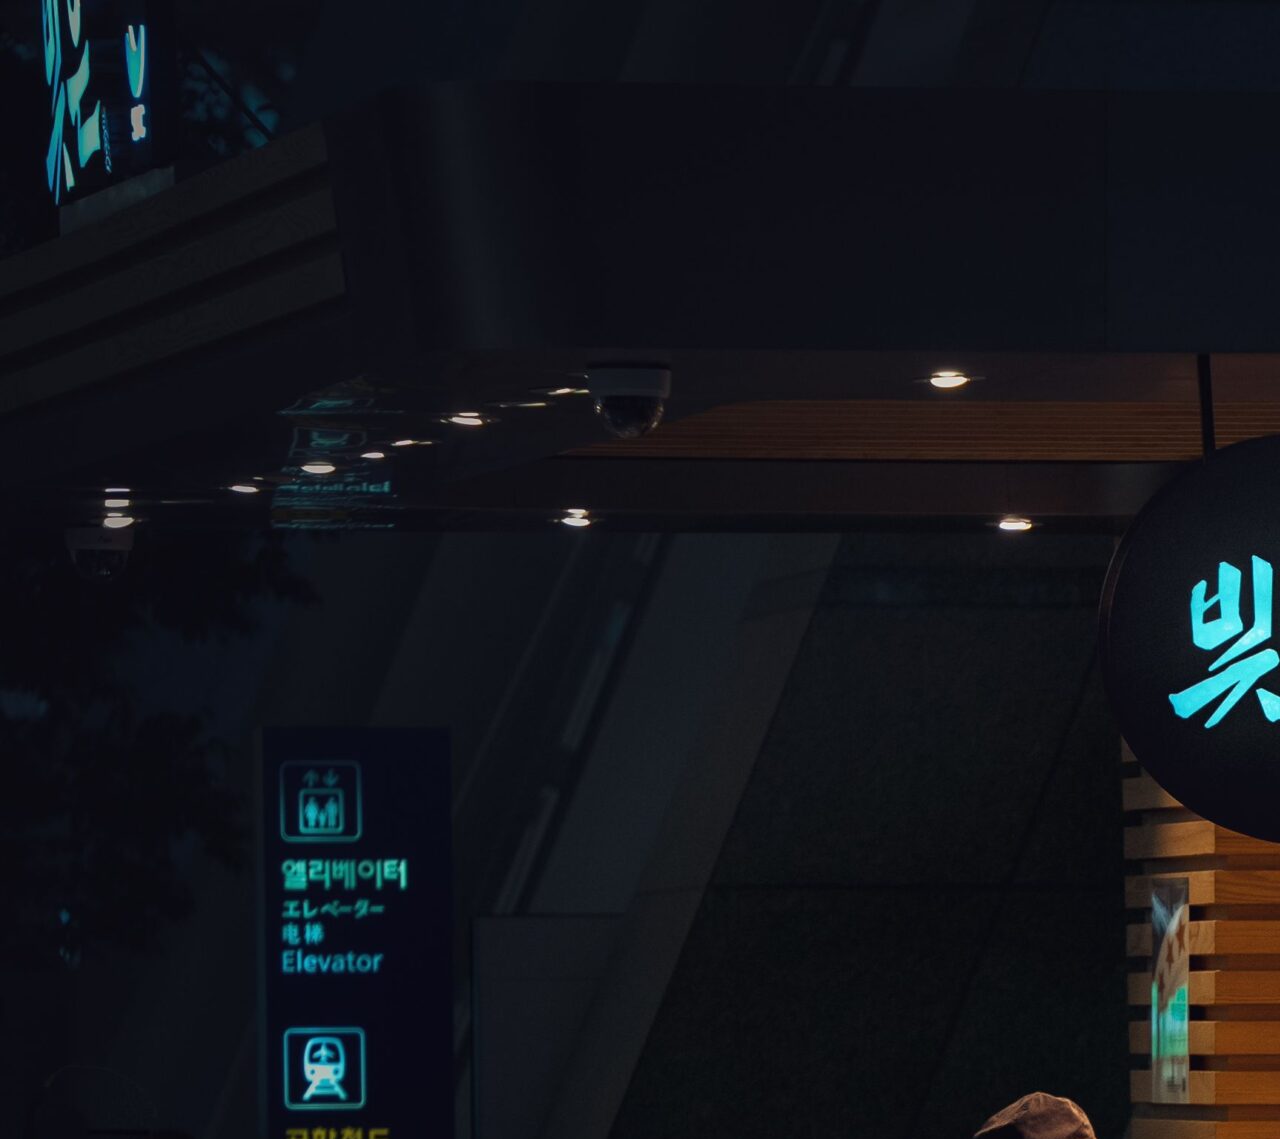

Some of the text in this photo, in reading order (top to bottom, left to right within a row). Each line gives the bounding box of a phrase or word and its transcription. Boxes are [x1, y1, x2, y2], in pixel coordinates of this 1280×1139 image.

[281, 857, 409, 892] 엘리베이터
[281, 898, 386, 920] エレベーター
[280, 921, 326, 946] 电梯
[280, 948, 384, 974] Elevator
